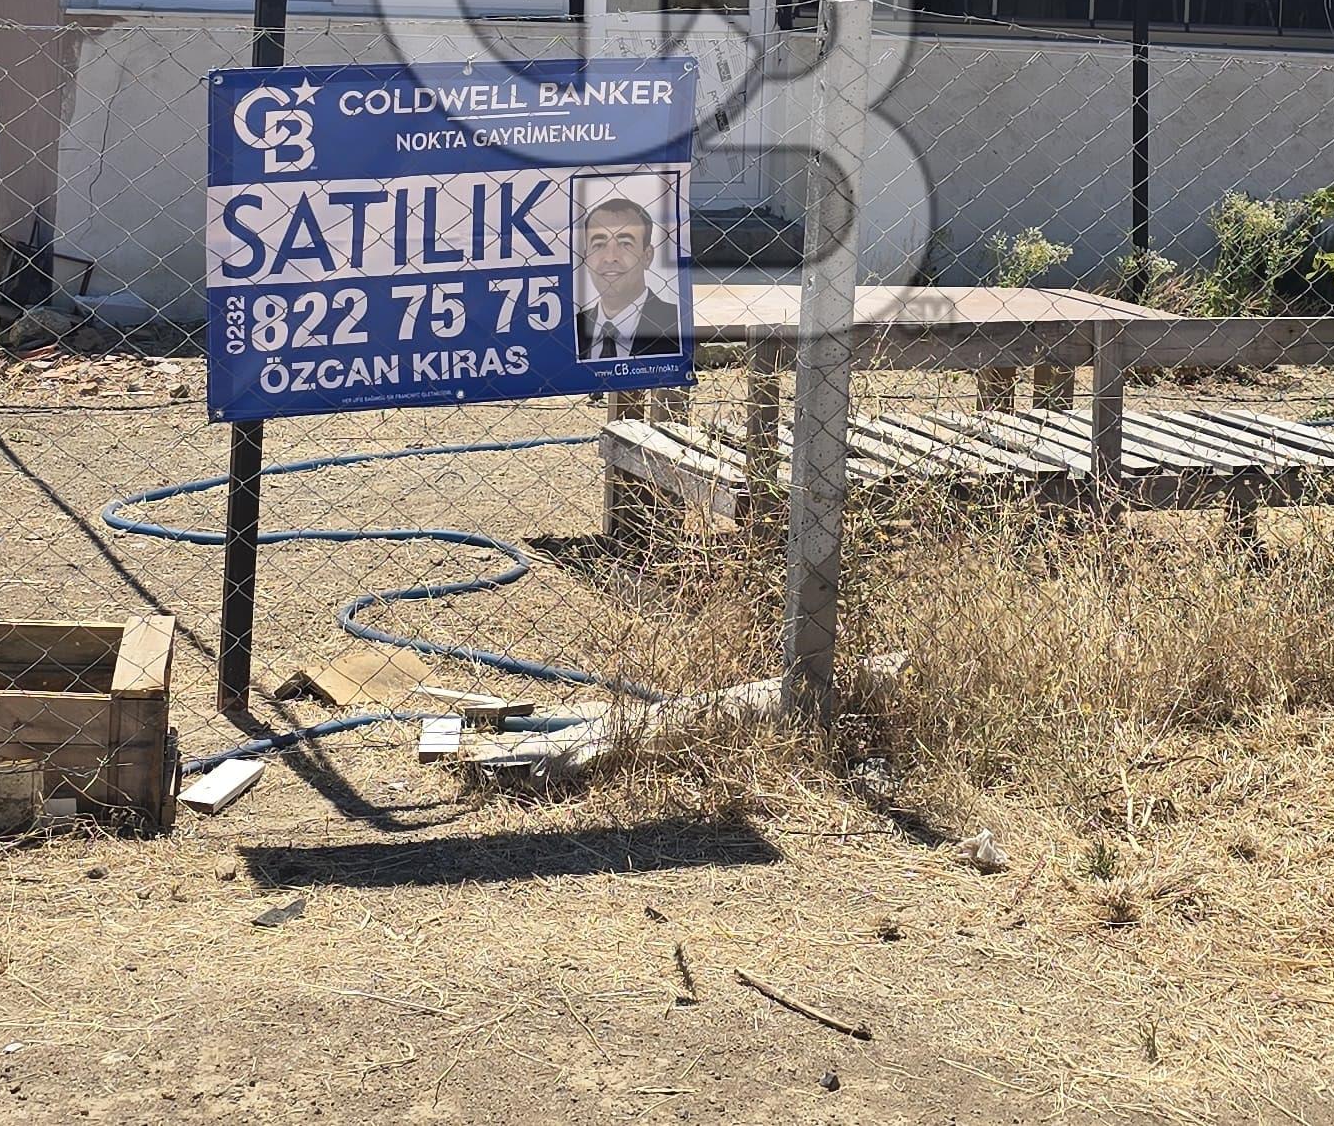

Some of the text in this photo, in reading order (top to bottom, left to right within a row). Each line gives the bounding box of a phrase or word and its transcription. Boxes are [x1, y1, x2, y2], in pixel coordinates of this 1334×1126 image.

[339, 80, 674, 116] COLDWELL BANKER
[234, 86, 316, 174] CB
[397, 121, 617, 153] NOKTA GAYRİMENKUL
[222, 180, 555, 279] SATILIK
[226, 294, 246, 355] 0232
[252, 276, 562, 352] 822 75 75
[260, 345, 530, 394] ÖZCAN KIRAS
